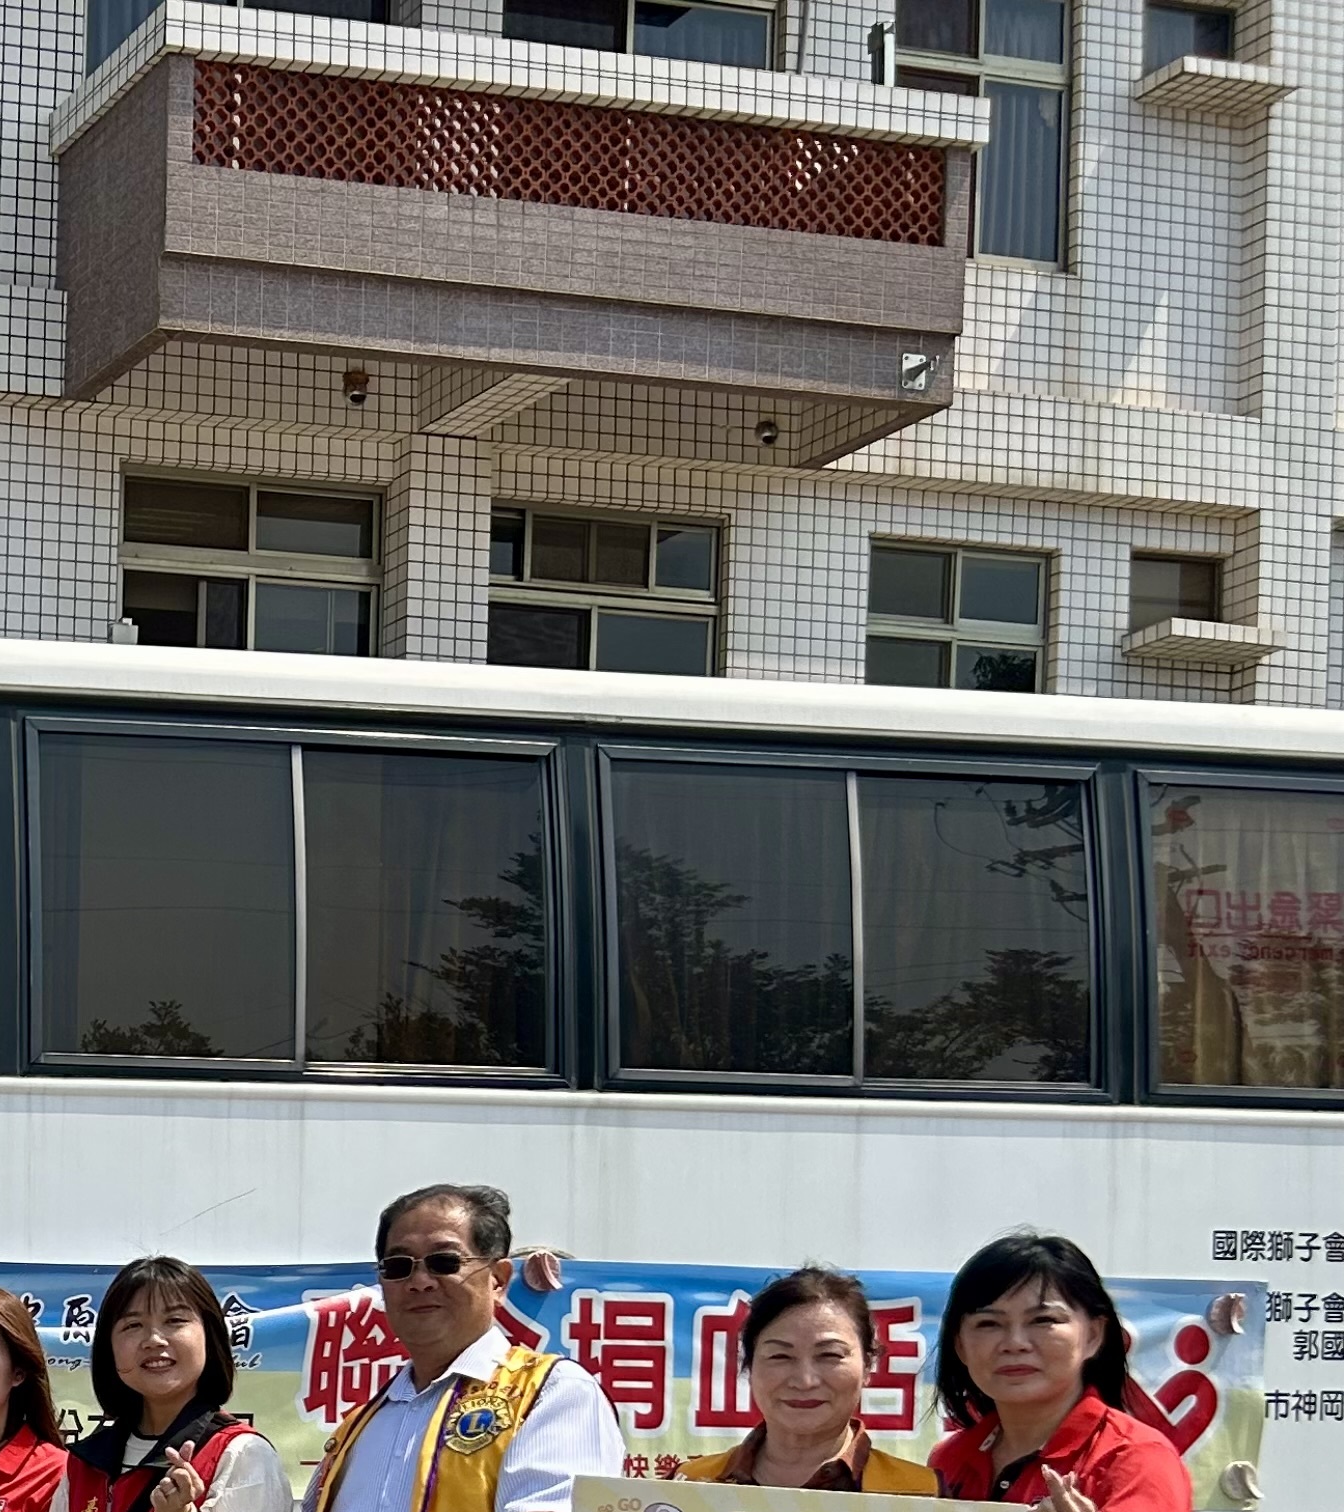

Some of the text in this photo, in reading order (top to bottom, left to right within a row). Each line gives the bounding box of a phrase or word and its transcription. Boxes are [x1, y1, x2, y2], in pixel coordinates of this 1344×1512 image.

[1211, 1229, 1344, 1263] 國際獅子會
[1265, 1290, 1344, 1324] 獅子會
[466, 1411, 486, 1434] L
[1264, 1389, 1344, 1423] 市神岡
[617, 1497, 643, 1512] GO
